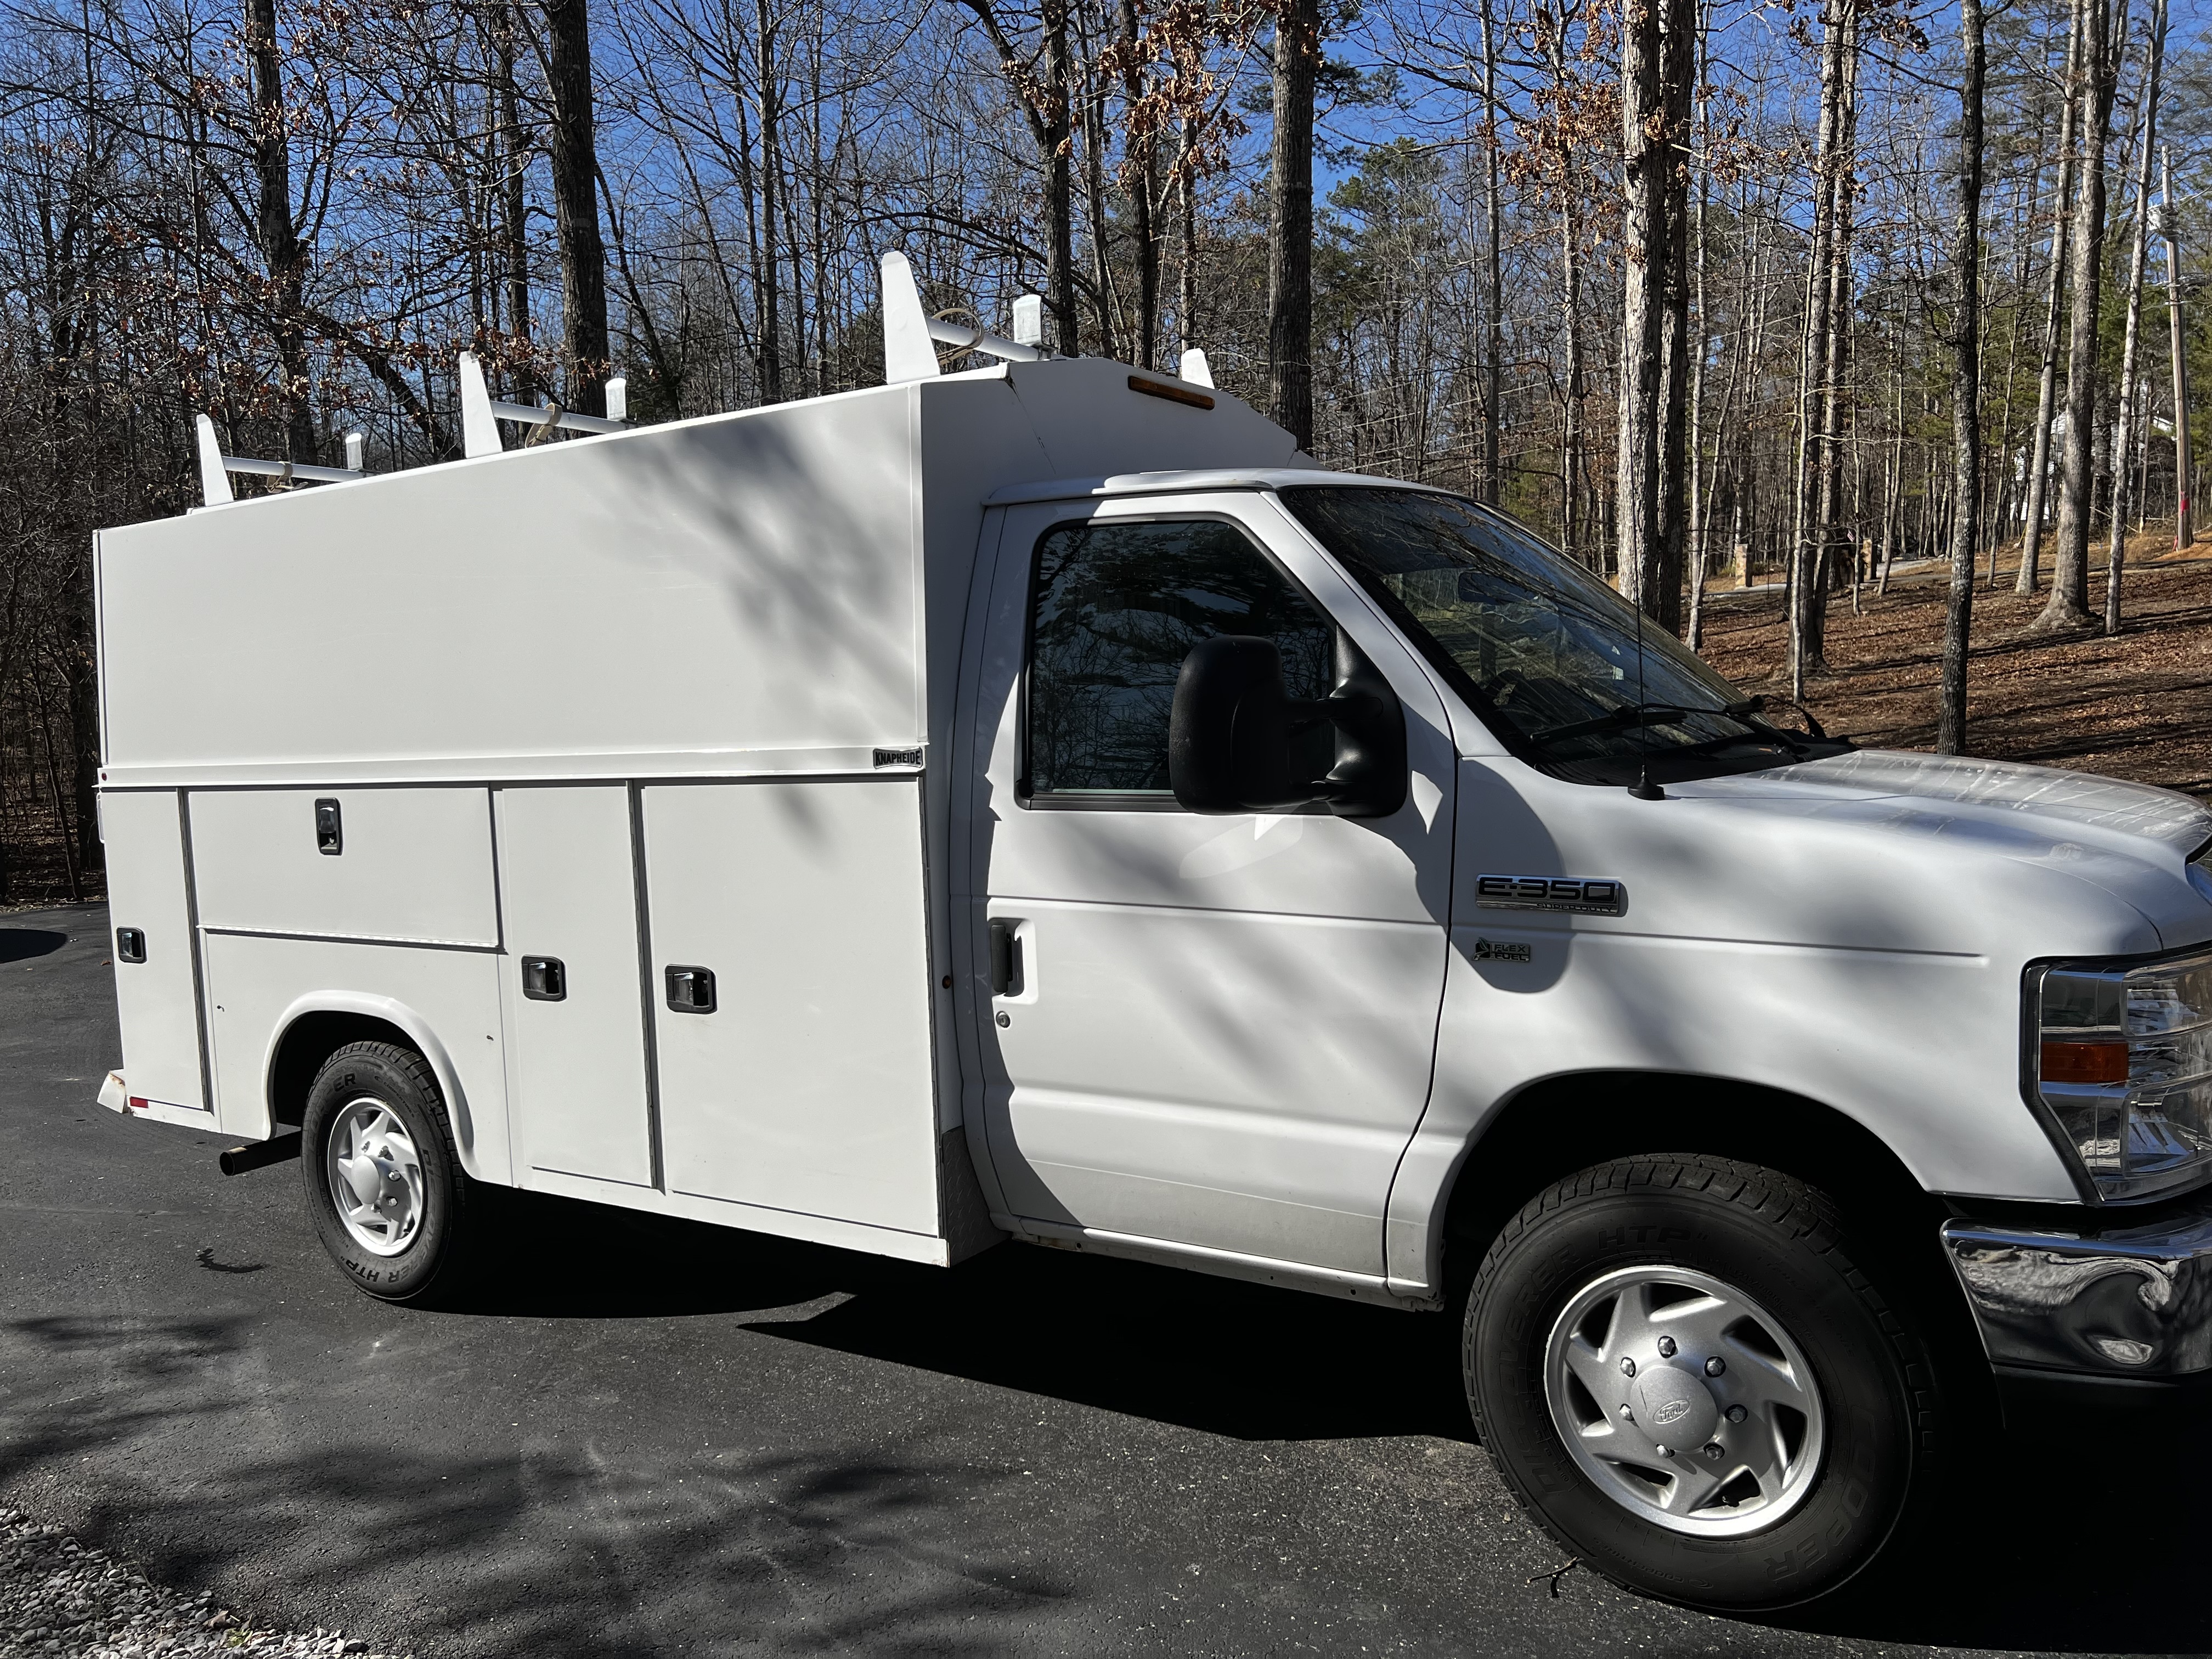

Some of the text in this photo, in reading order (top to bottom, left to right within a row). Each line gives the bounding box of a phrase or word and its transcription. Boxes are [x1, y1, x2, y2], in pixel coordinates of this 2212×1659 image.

[874, 750, 921, 766] KNAPHEIDE
[1479, 877, 1616, 901] E-350
[1536, 902, 1576, 911] SUPER
[1494, 943, 1527, 952] FLEX
[1494, 952, 1527, 961] FUEL
[1498, 1243, 1581, 1494] DISCOVERER
[1657, 1402, 1684, 1423] Ford
[1762, 1404, 1877, 1582] COOPER
